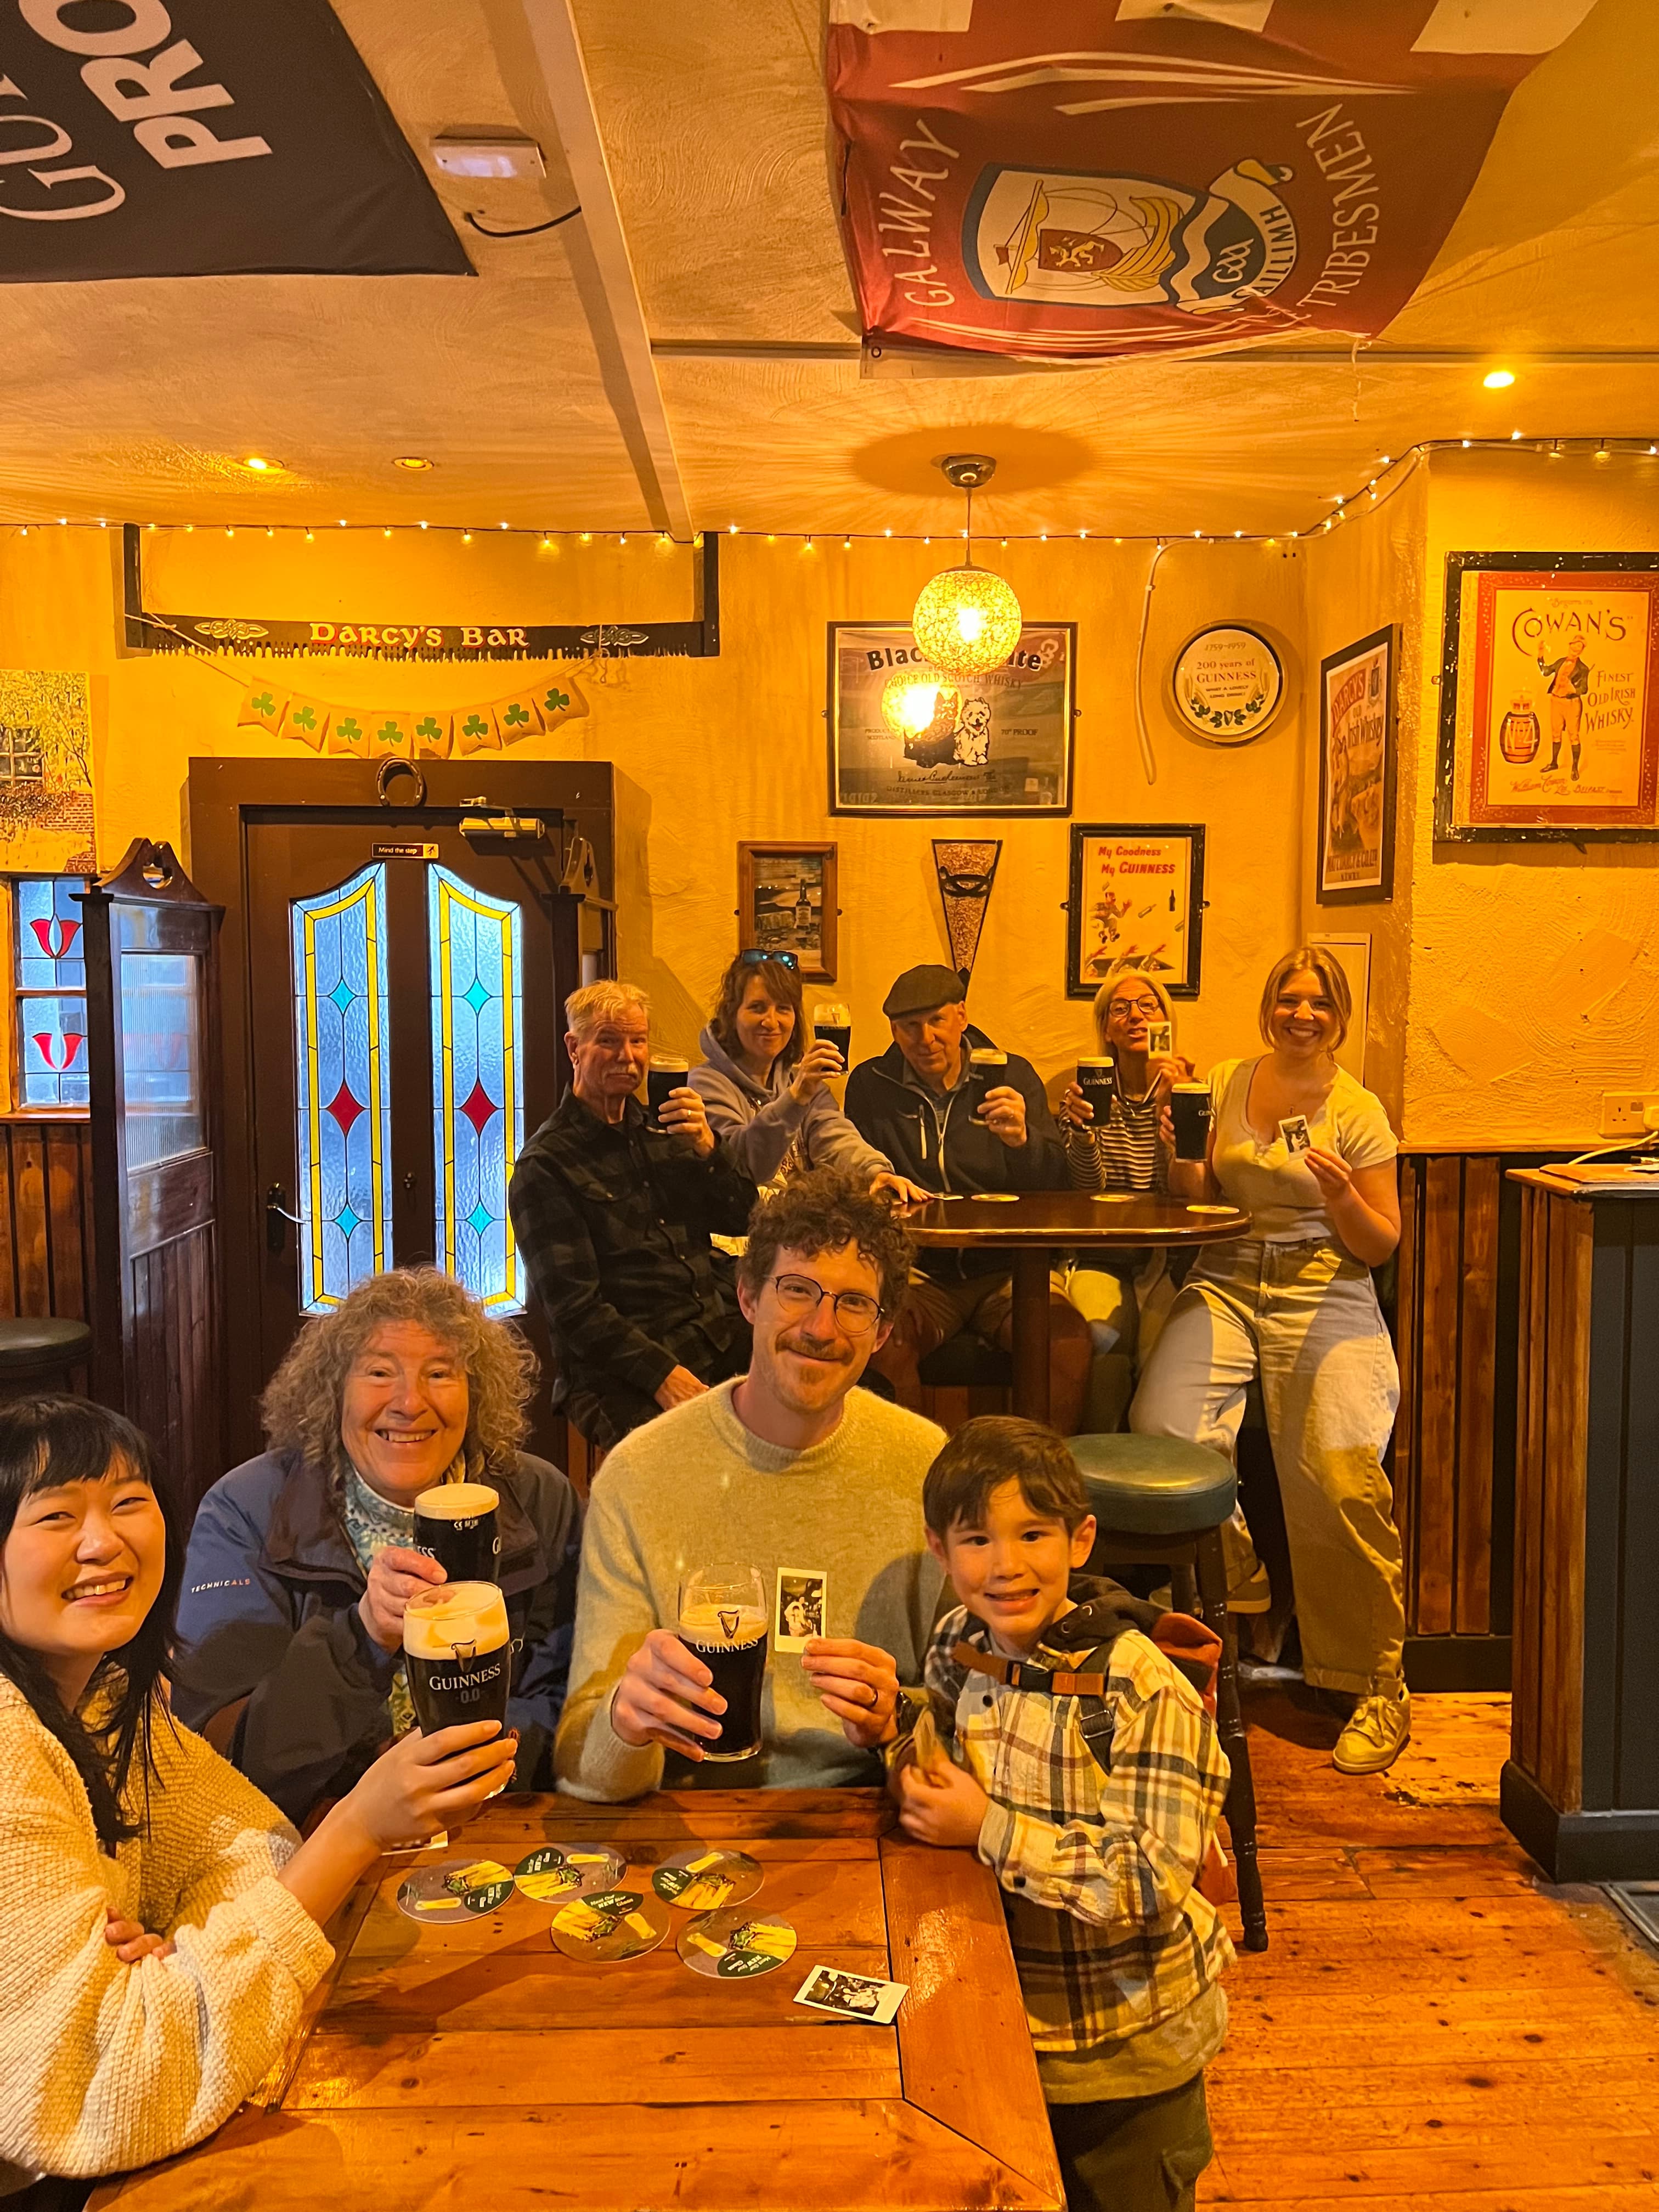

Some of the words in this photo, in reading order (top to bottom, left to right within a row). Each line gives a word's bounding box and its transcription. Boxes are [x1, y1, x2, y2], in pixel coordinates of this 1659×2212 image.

[1296, 103, 1380, 306] TRIBESMEN
[878, 119, 959, 307] GALWAY
[866, 647, 928, 670] Blac
[1197, 661, 1216, 669] 200
[1220, 662, 1242, 670] years
[1246, 658, 1255, 666] of
[921, 673, 940, 684] OLD
[943, 674, 980, 684] SCOTCH
[985, 674, 1023, 689] WHISKY
[1197, 671, 1256, 683] GUINNESS
[1596, 670, 1634, 687] FINEST
[1588, 692, 1609, 707] OLD
[1611, 687, 1636, 706] IRISH
[1098, 846, 1112, 859] My
[1116, 845, 1161, 856] Goodness
[1102, 864, 1115, 877] My
[1119, 861, 1176, 874] GUINNESS
[1083, 1076, 1113, 1086] GUINNESS
[191, 1578, 250, 1593] TECHNICALS
[696, 1638, 758, 1654] GUINNESS
[429, 1663, 500, 1690] GUINNESS
